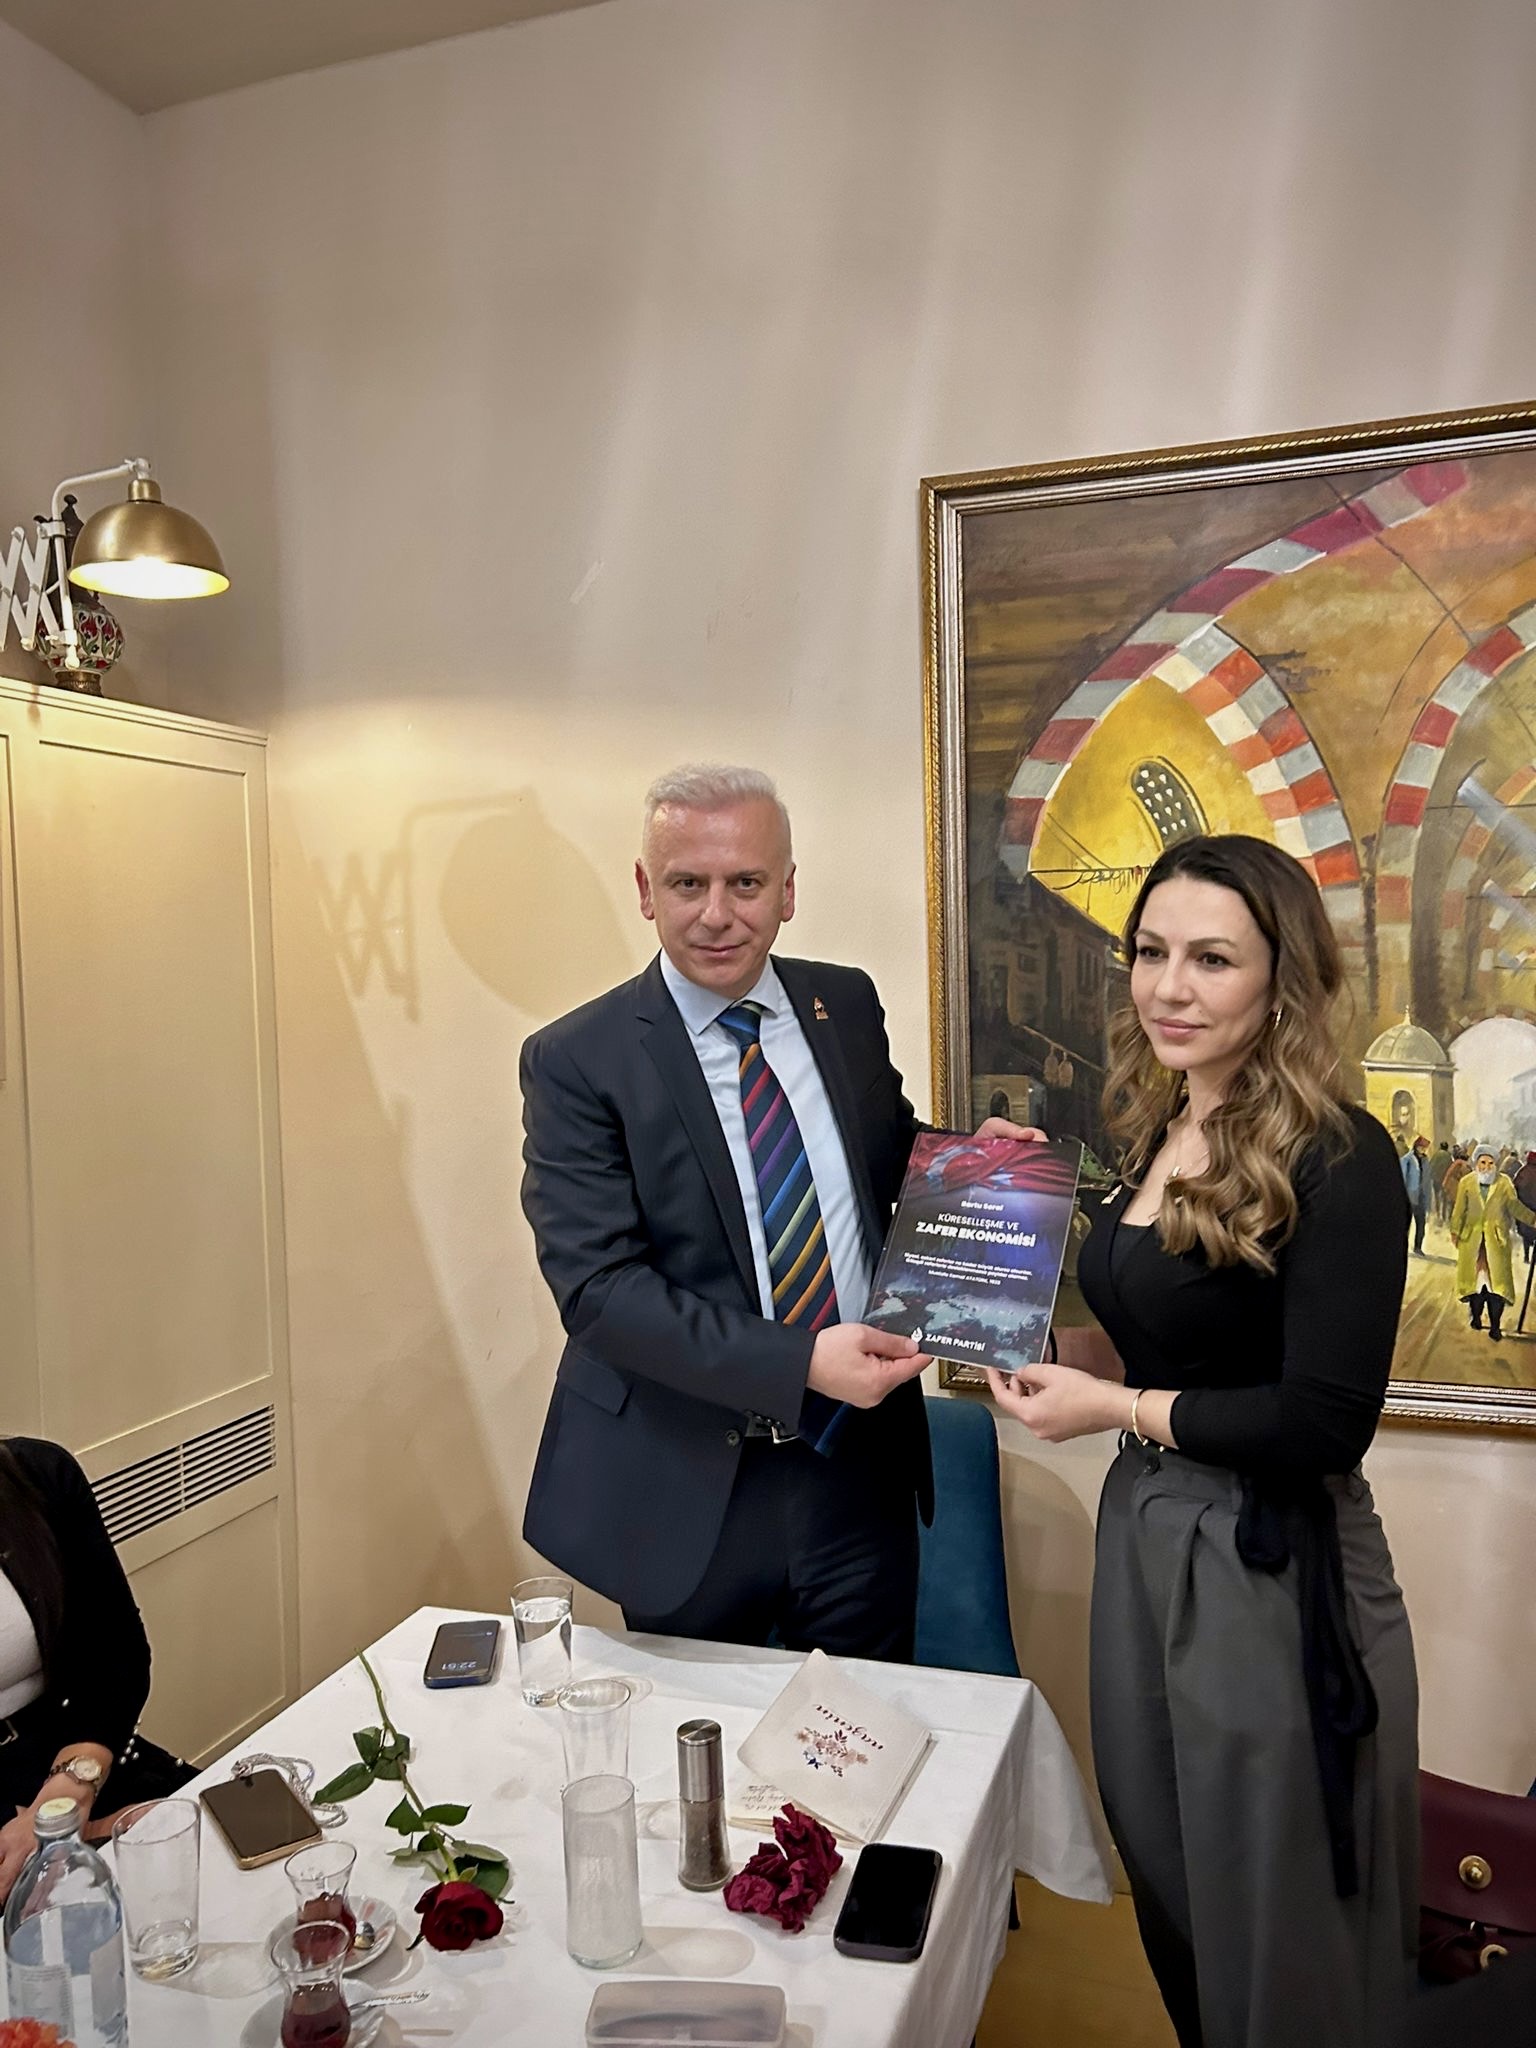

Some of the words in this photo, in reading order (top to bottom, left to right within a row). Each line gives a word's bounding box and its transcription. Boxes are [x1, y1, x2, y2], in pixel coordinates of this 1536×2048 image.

[938, 1213, 1005, 1229] KÜRESELLEŞME
[1007, 1221, 1020, 1231] VE
[916, 1222, 959, 1238] ZAFER
[958, 1227, 1036, 1247] EKONOMİSİ
[925, 1333, 953, 1346] ZAFER
[952, 1338, 986, 1352] PARTİSİ
